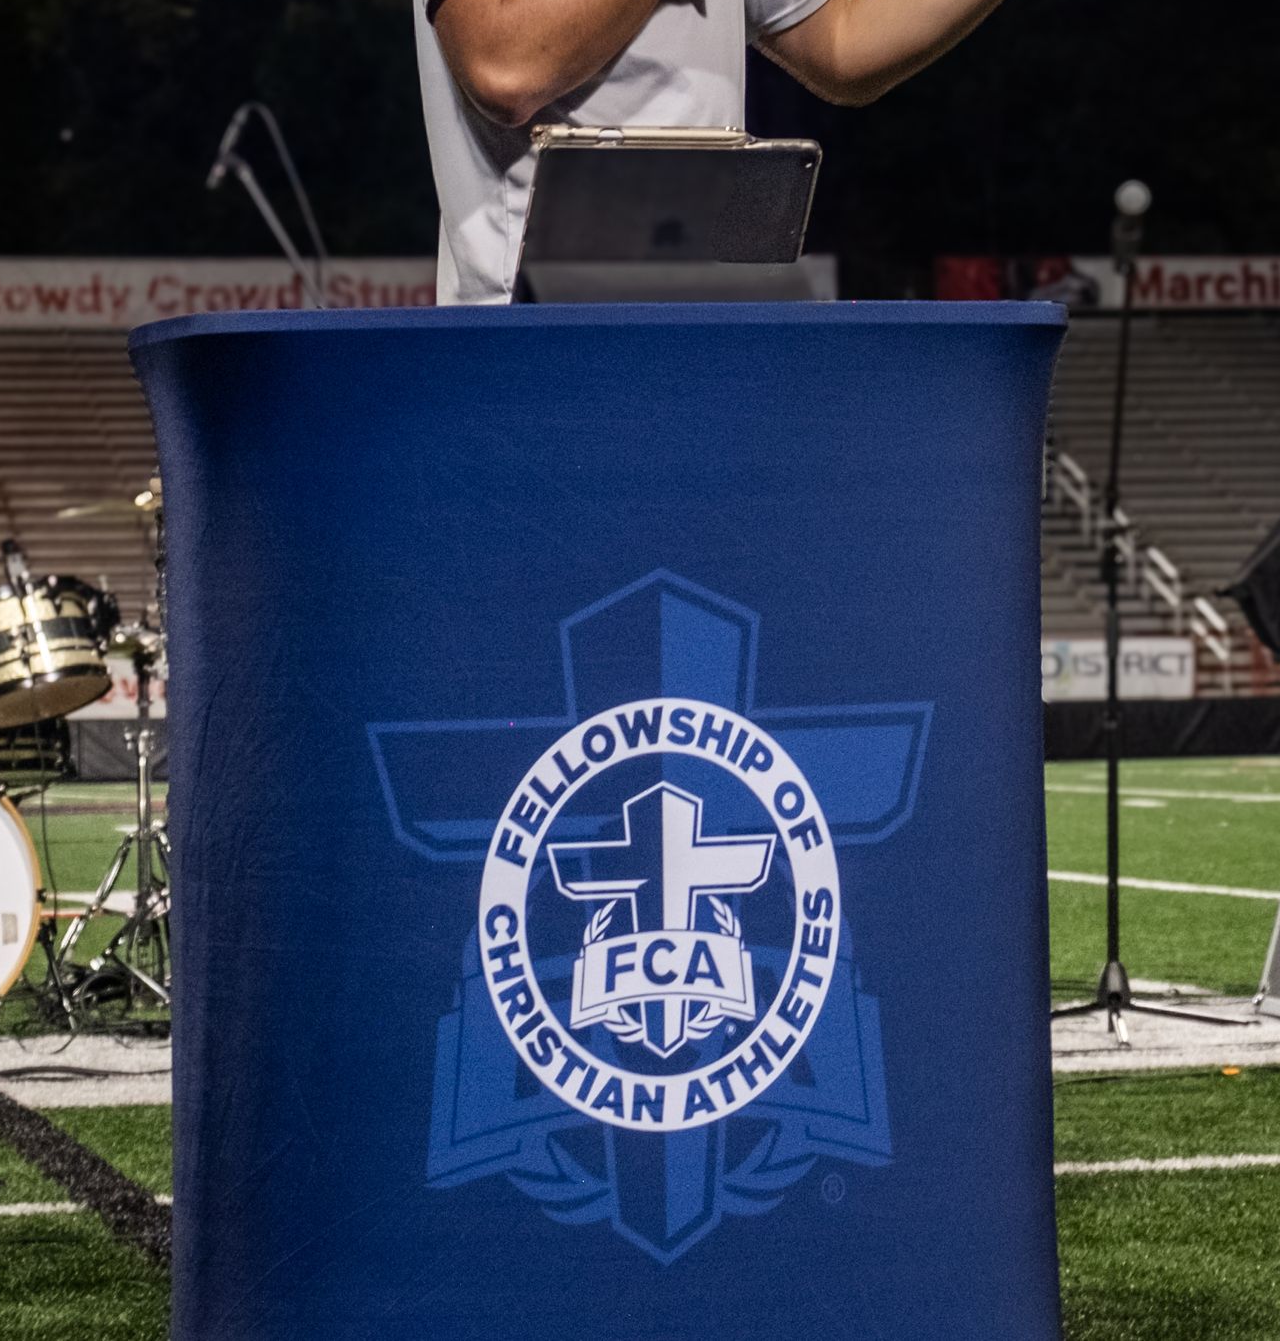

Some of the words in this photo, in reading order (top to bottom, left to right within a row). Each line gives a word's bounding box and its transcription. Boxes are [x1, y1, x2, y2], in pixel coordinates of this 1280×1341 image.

[496, 705, 775, 870] FELLOWSHIP
[774, 780, 824, 854] OF
[486, 904, 665, 1124] CHRISTIAN
[683, 887, 834, 1122] ATHLETES
[605, 938, 725, 993] FCA
